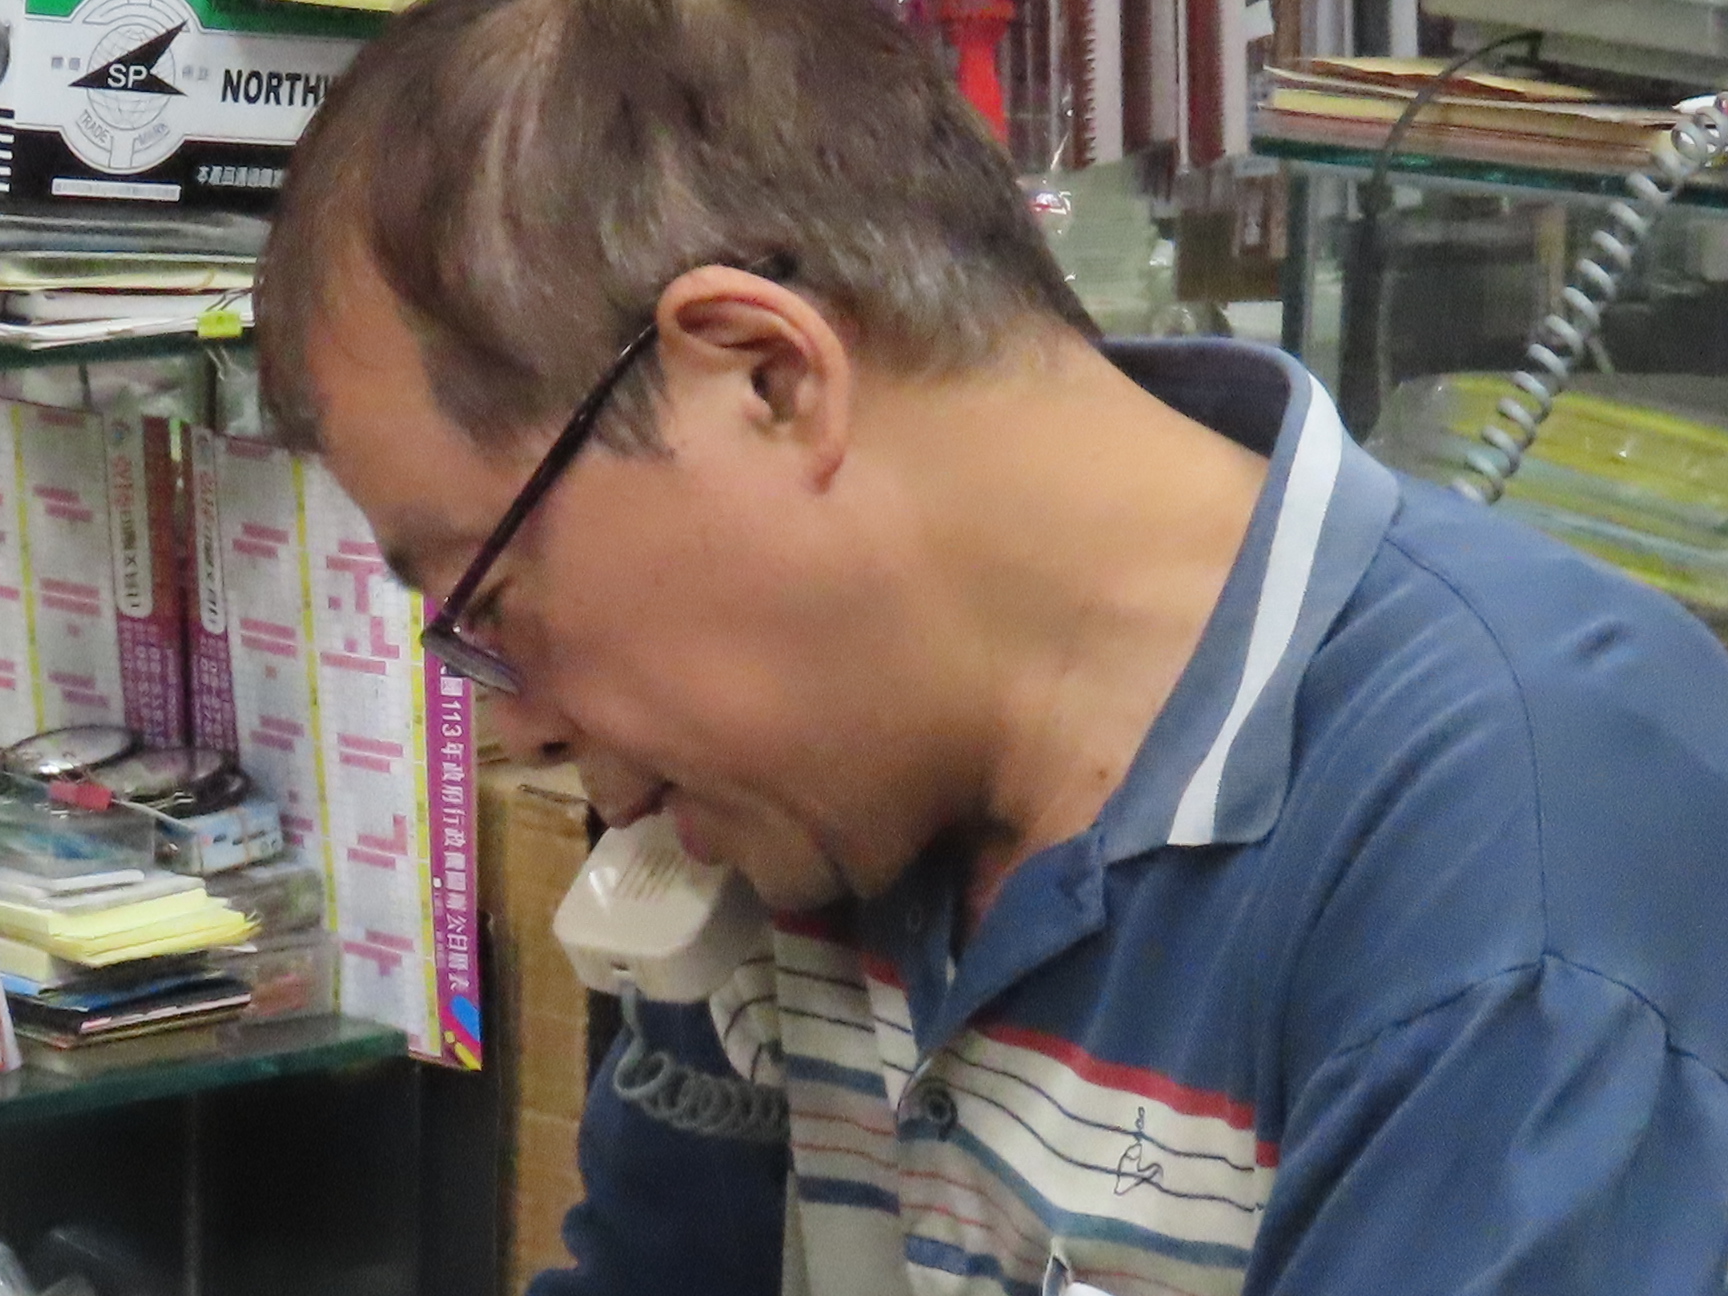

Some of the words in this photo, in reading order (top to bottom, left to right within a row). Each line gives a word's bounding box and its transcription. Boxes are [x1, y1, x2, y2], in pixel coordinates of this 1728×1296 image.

[106, 63, 150, 89] SP
[439, 660, 471, 992] 國113年政府行政機關辦公日曆表
